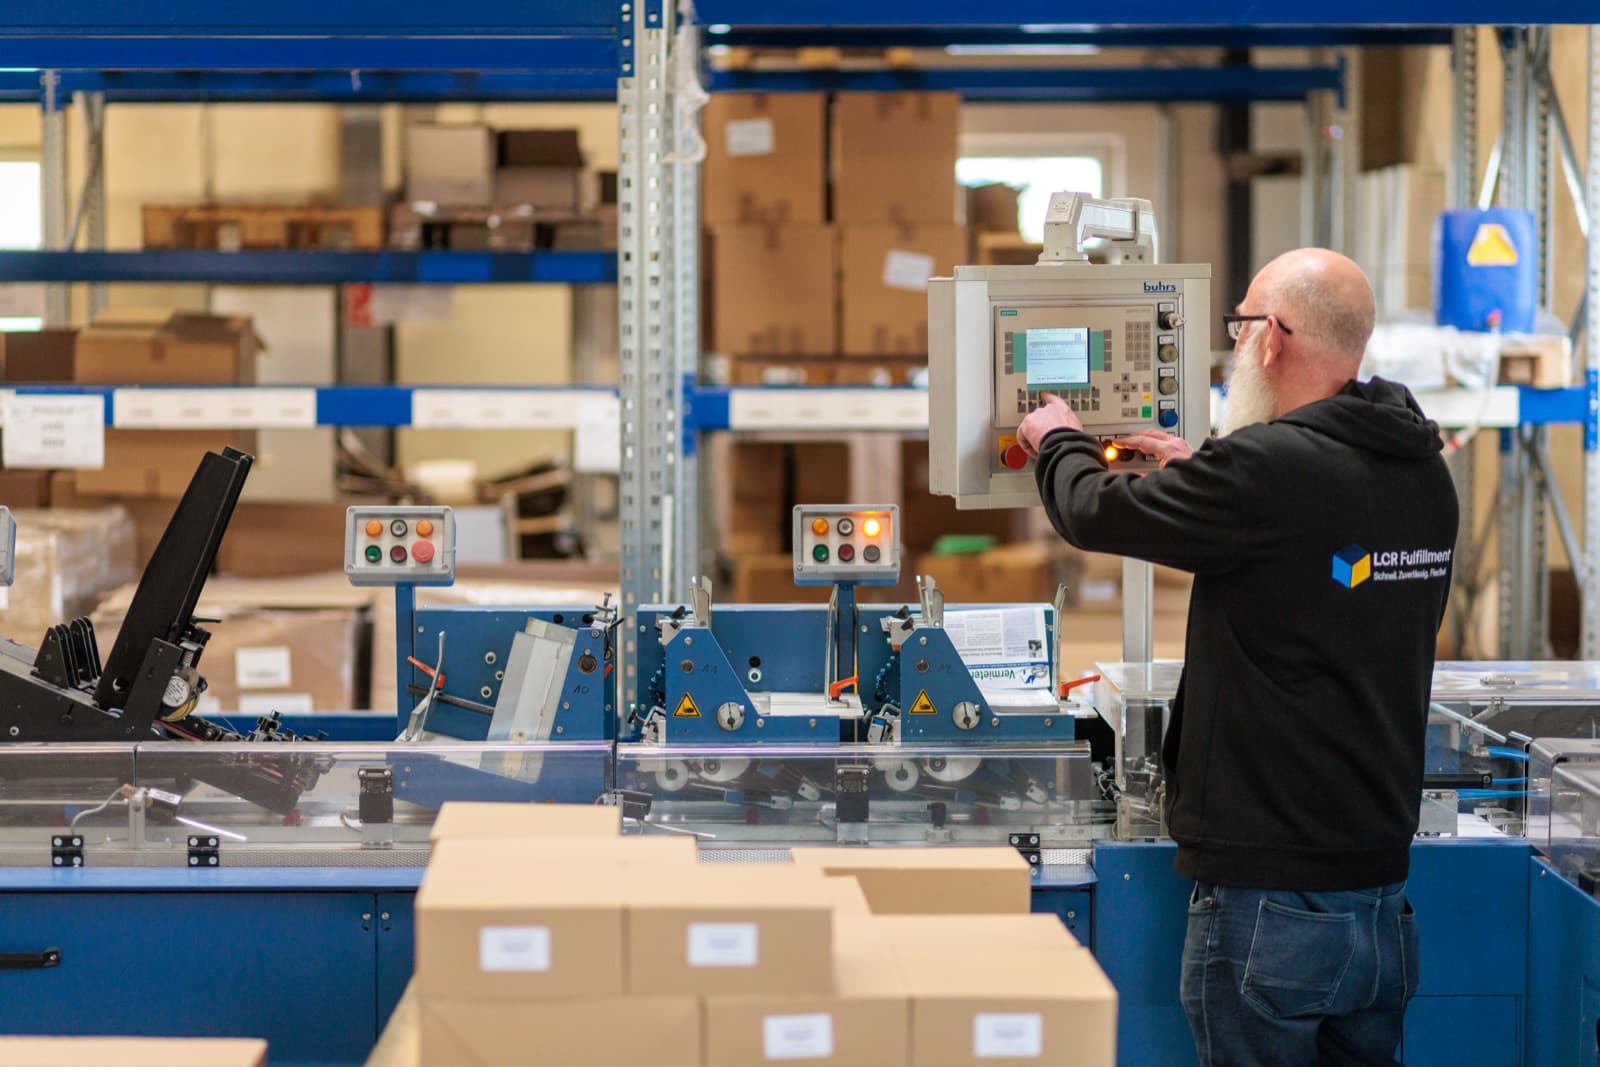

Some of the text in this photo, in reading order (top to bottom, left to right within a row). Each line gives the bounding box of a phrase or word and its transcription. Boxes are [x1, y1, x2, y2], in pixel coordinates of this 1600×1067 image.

[1143, 281, 1176, 291] buhrs
[1373, 547, 1451, 567] LCR Fulfillment
